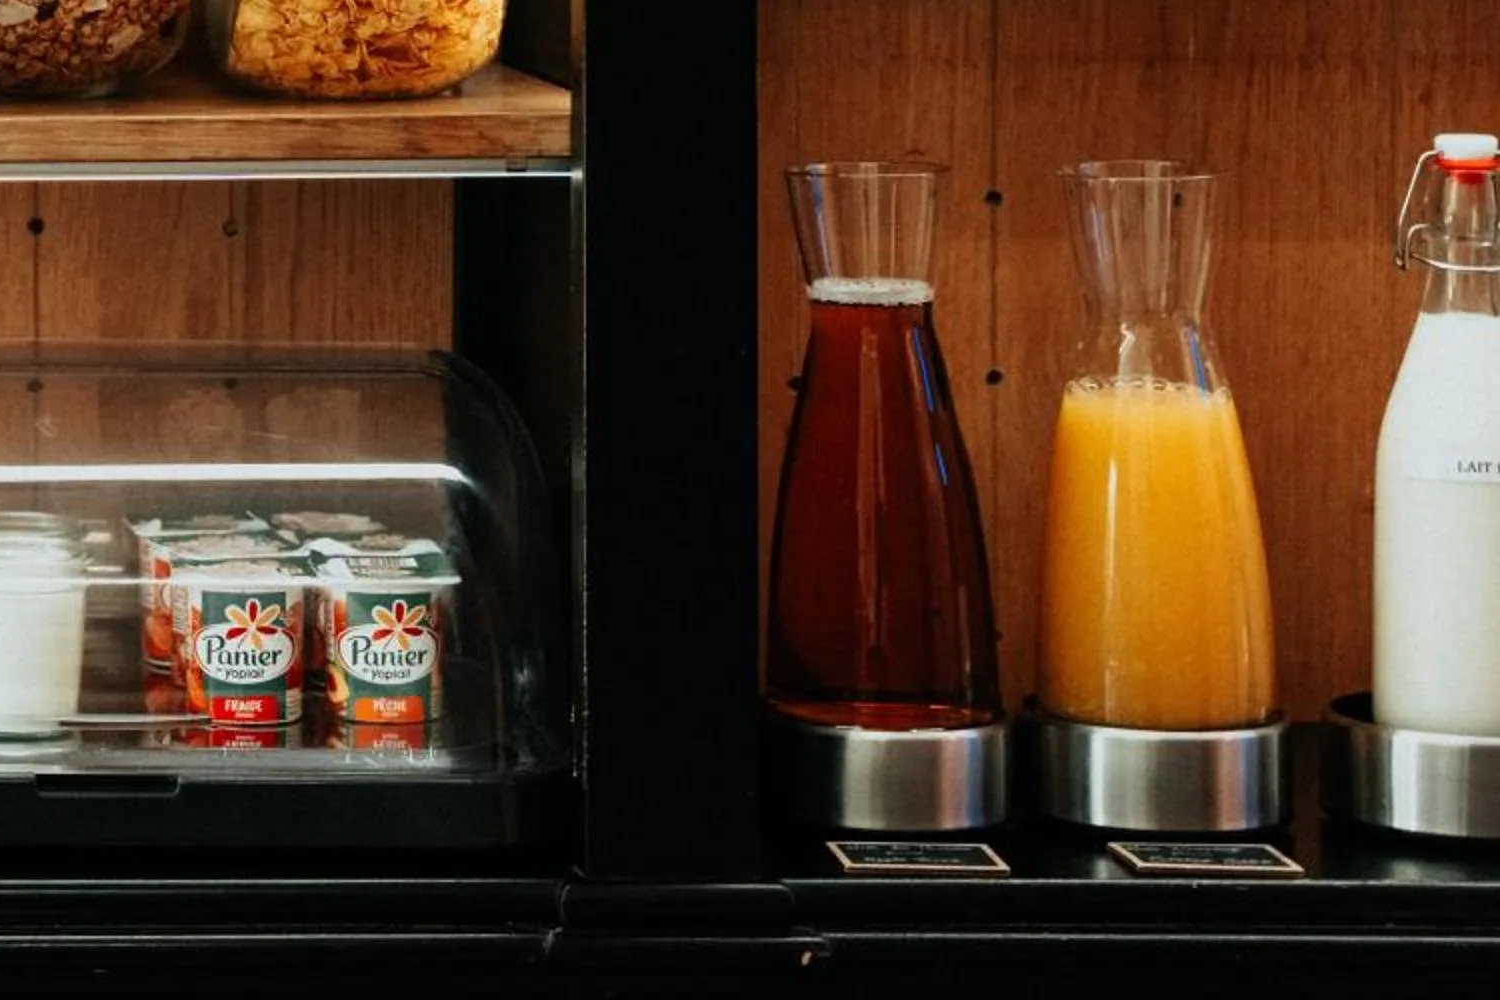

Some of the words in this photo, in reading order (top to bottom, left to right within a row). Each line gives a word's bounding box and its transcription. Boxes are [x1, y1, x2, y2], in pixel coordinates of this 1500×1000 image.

[1457, 460, 1493, 473] LAIT
[202, 635, 283, 667] Panier
[347, 634, 429, 667] Panier
